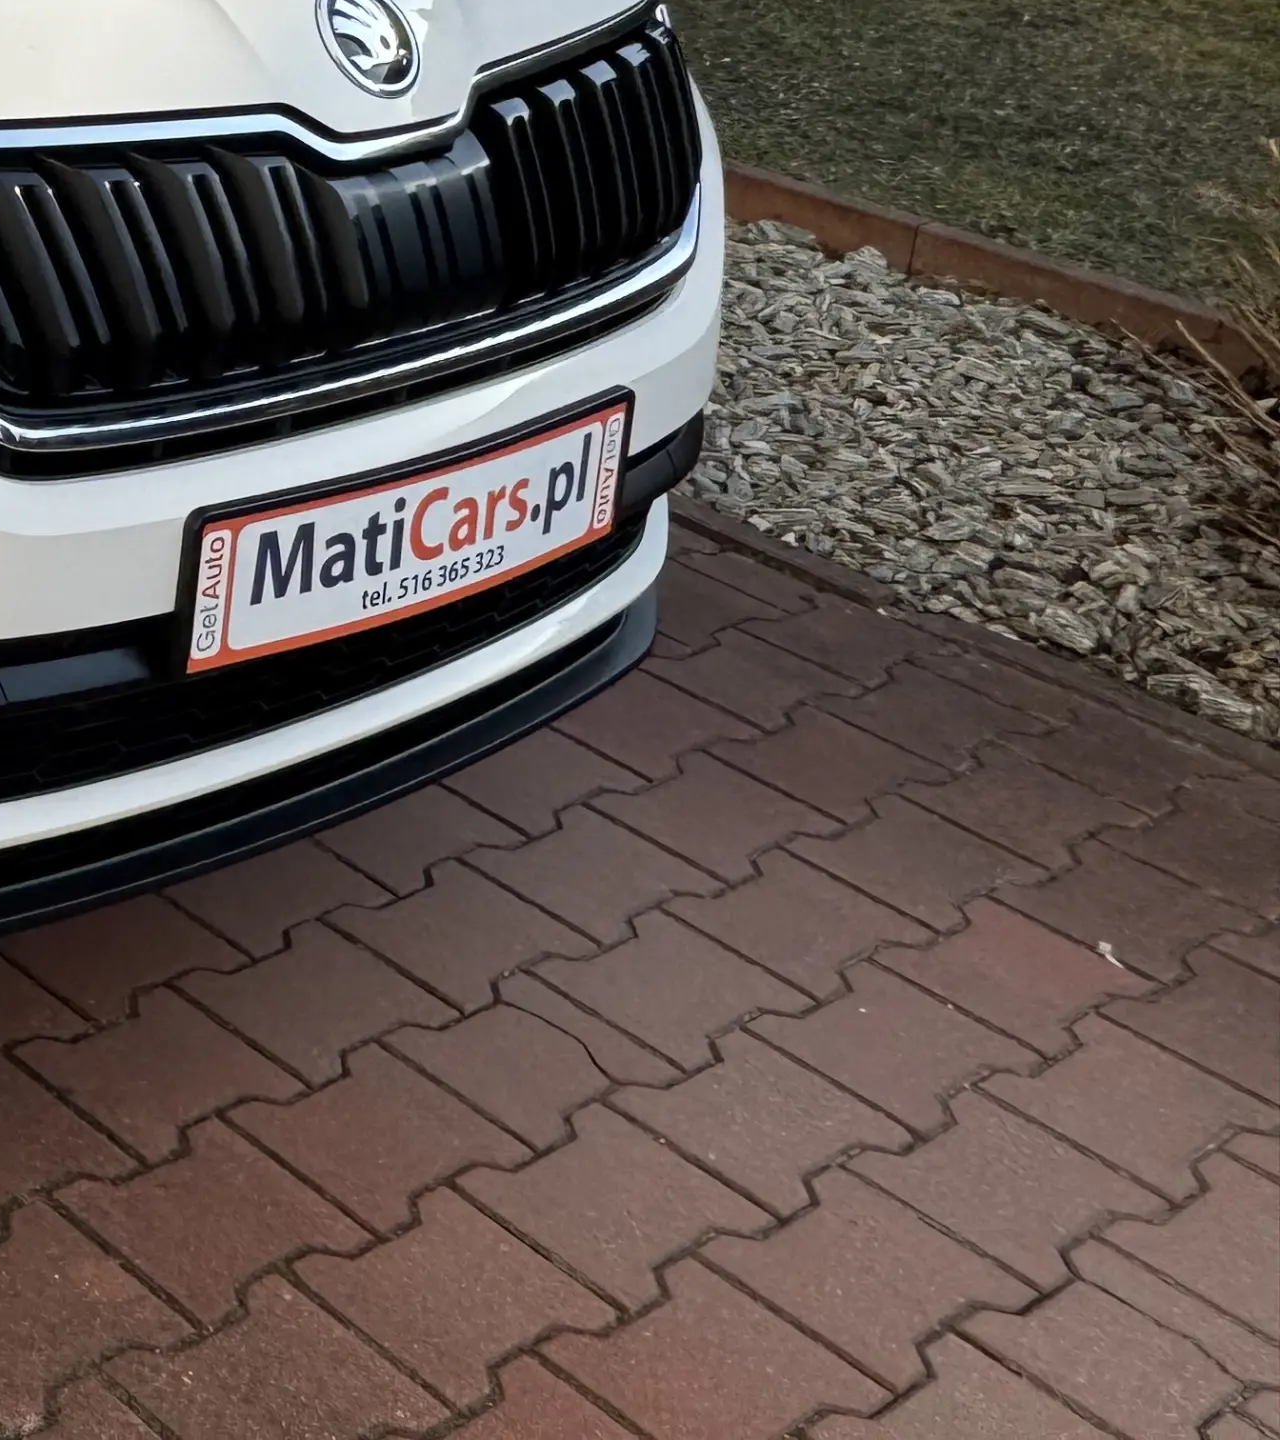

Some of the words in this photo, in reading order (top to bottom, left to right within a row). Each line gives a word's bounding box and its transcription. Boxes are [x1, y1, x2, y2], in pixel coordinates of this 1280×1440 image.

[250, 432, 592, 606] MatiCars.pl
[362, 581, 392, 610] tel.
[397, 569, 432, 600] 516
[437, 557, 470, 587] 365
[473, 545, 505, 574] 323
